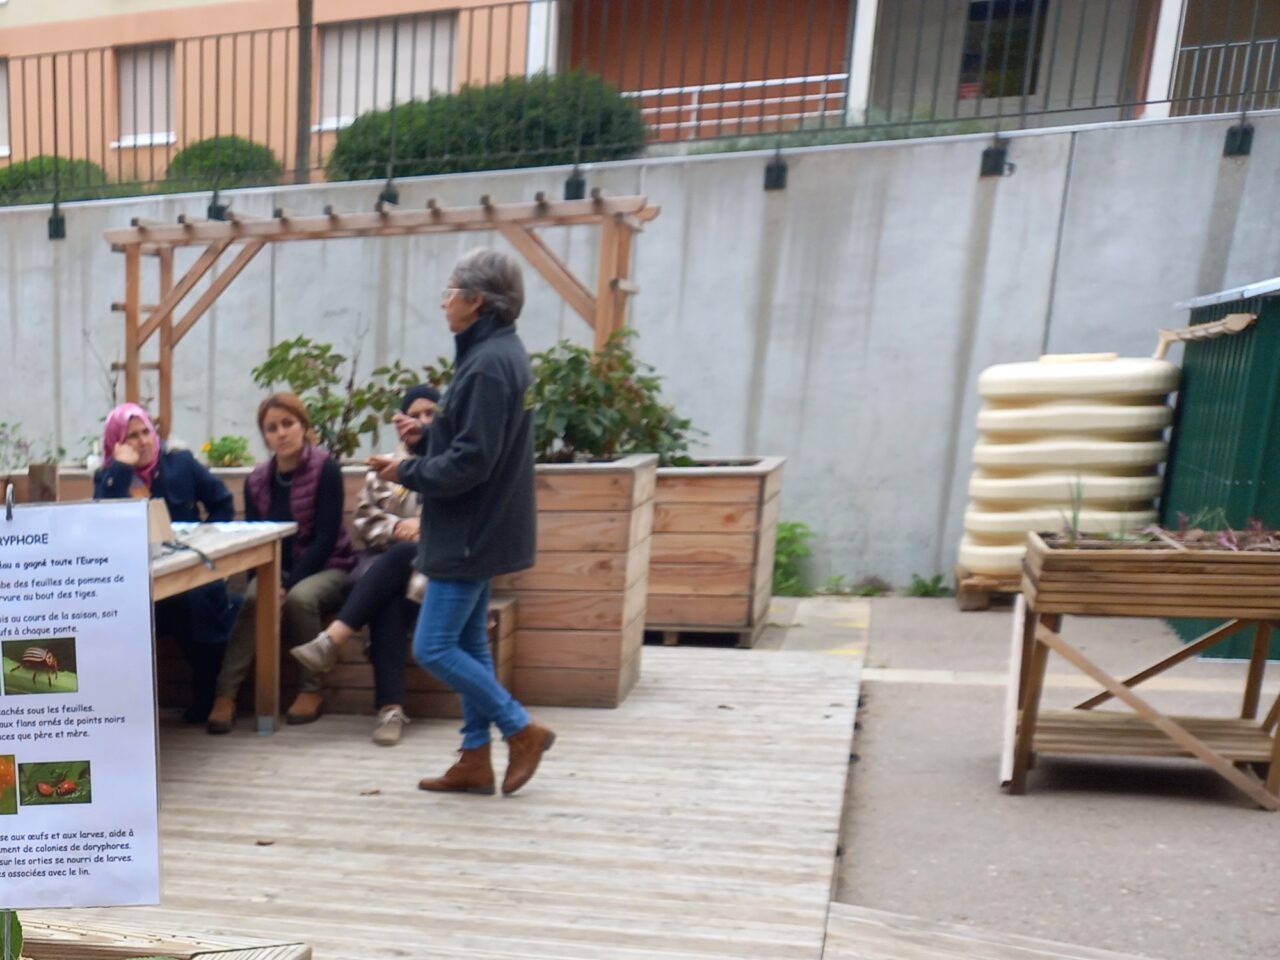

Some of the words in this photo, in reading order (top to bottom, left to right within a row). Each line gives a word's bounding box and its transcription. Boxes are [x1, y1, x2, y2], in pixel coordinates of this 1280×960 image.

[23, 557, 47, 570] gagné
[50, 558, 72, 566] toute
[13, 626, 19, 635] à
[21, 625, 50, 636] chaque
[46, 705, 59, 713] les
[16, 732, 31, 742] que
[33, 730, 53, 741] père
[54, 730, 64, 738] et
[22, 844, 33, 853] de
[35, 843, 68, 852] colonies
[69, 842, 80, 851] de
[7, 868, 46, 877] associées
[68, 867, 76, 875] le
